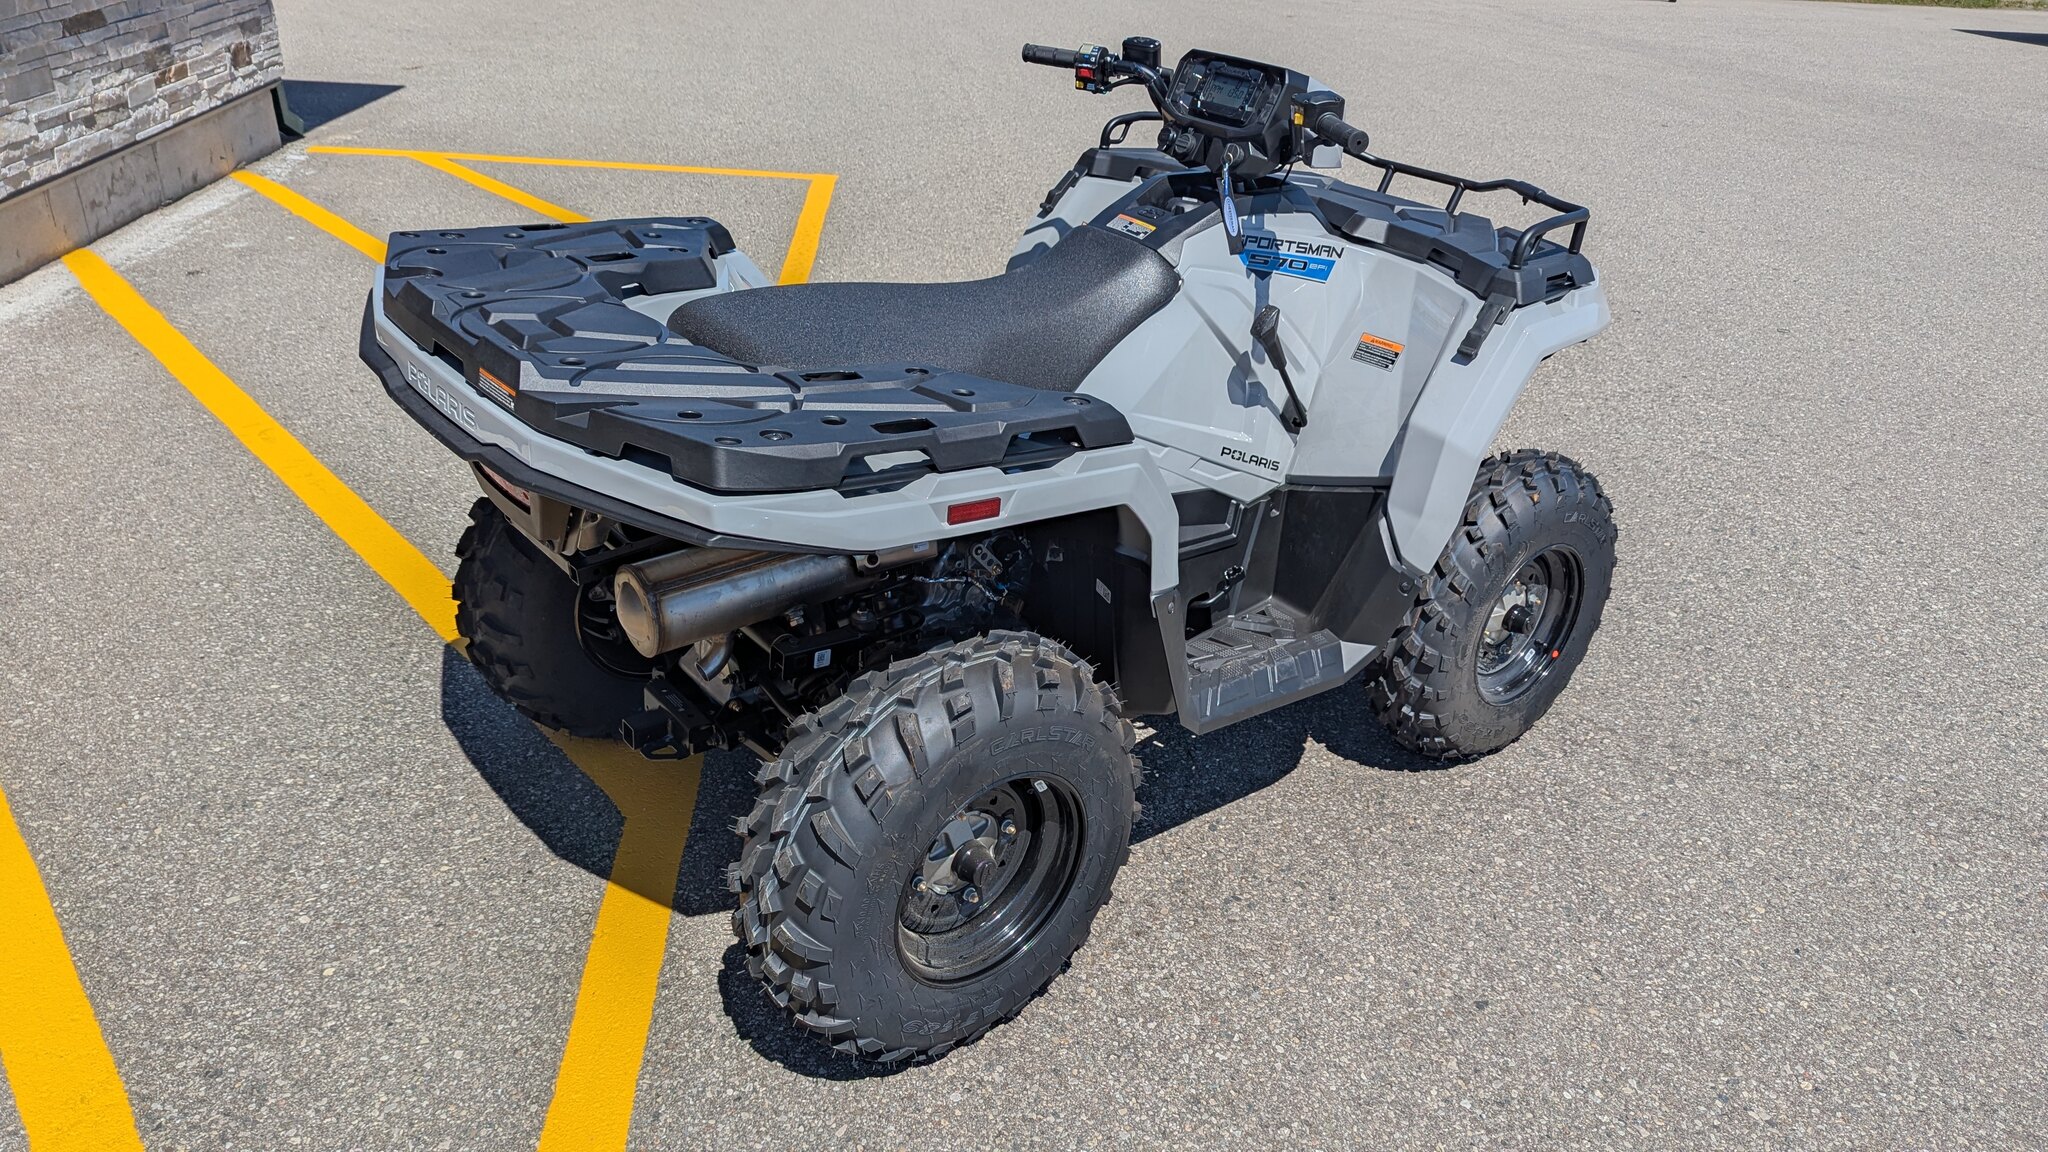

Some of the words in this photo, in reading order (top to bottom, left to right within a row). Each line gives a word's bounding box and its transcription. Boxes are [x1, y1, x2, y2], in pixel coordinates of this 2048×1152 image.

[1249, 253, 1308, 271] 570
[406, 360, 480, 432] POLARIS
[1220, 446, 1280, 472] POLARIS
[988, 725, 1097, 756] CARLSTAR
